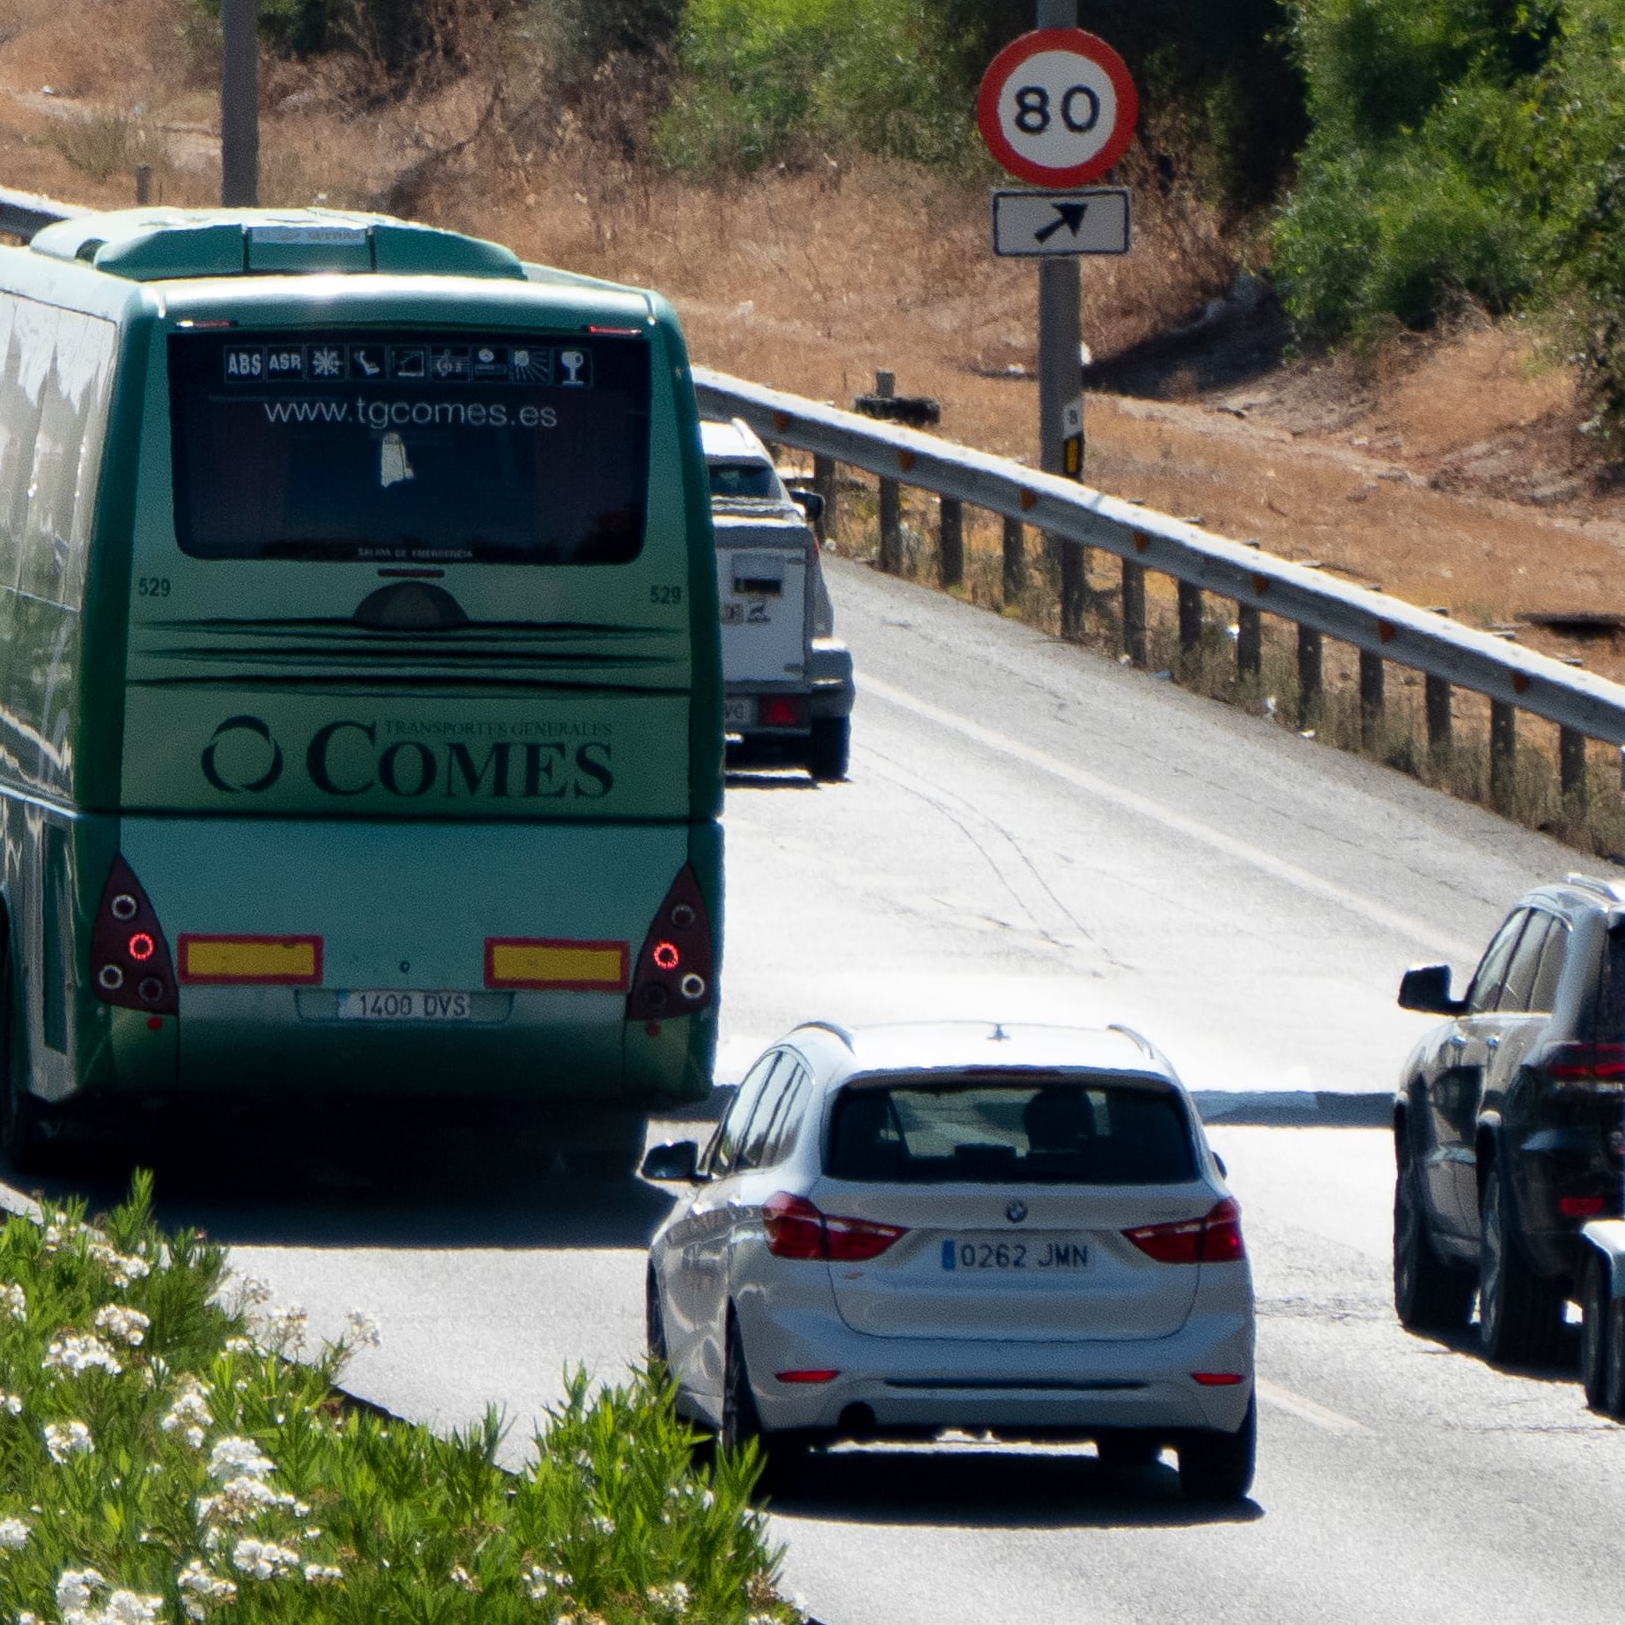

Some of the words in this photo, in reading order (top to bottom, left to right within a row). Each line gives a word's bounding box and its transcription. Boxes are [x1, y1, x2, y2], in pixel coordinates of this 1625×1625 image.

[1014, 84, 1101, 135] 80
[227, 352, 262, 376] ABS
[268, 351, 302, 371] ASR
[263, 396, 558, 430] www.tgcomes.es
[138, 578, 172, 597] 529
[650, 585, 681, 604] 529
[306, 719, 615, 799] COMES
[359, 994, 413, 1016] 1400
[424, 995, 466, 1017] DVS
[960, 1244, 1027, 1268] 0262
[1039, 1244, 1089, 1268] JMN
